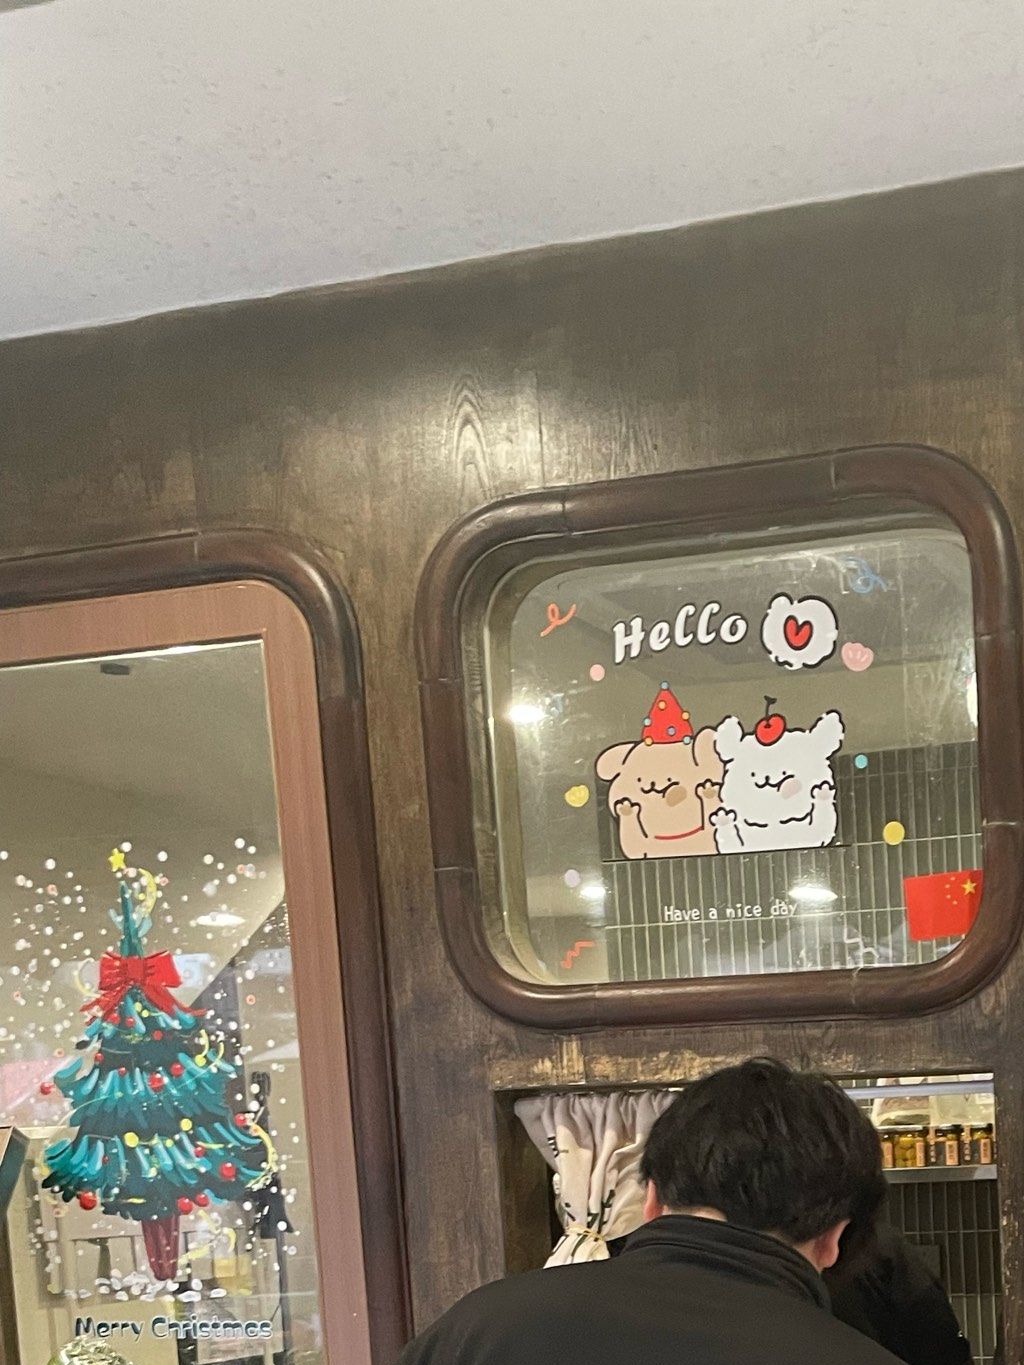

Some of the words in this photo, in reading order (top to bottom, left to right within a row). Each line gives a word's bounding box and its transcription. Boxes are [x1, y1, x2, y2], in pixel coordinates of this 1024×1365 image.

[612, 601, 748, 665] Hello
[664, 905, 700, 921] Have
[709, 907, 718, 919] a
[726, 903, 762, 918] nice
[770, 898, 798, 916] day
[75, 1317, 144, 1342] Merry
[151, 1315, 272, 1339] Christmas
